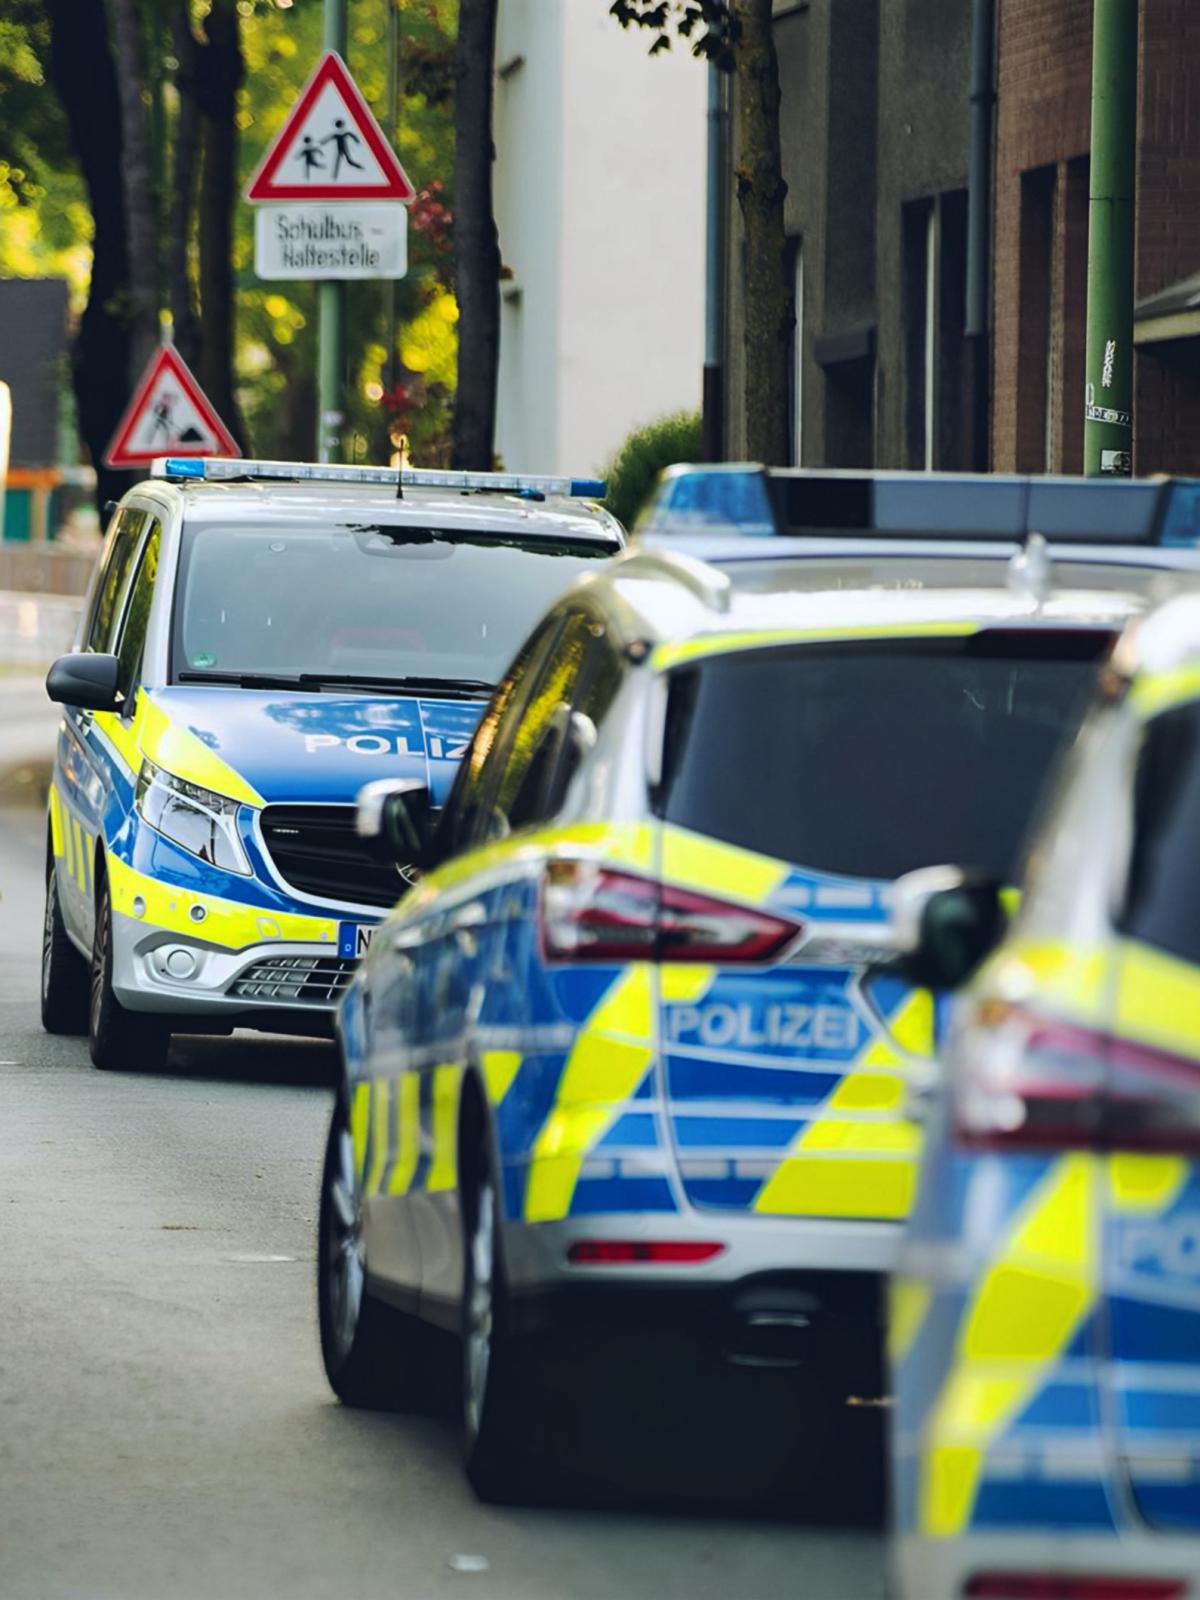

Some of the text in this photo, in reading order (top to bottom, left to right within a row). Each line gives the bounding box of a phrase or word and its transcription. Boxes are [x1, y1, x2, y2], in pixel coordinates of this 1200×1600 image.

[282, 243, 381, 269] Haltestelle
[304, 734, 470, 760] POLIZ
[357, 929, 372, 955] N
[671, 1003, 860, 1050] POLIZEI
